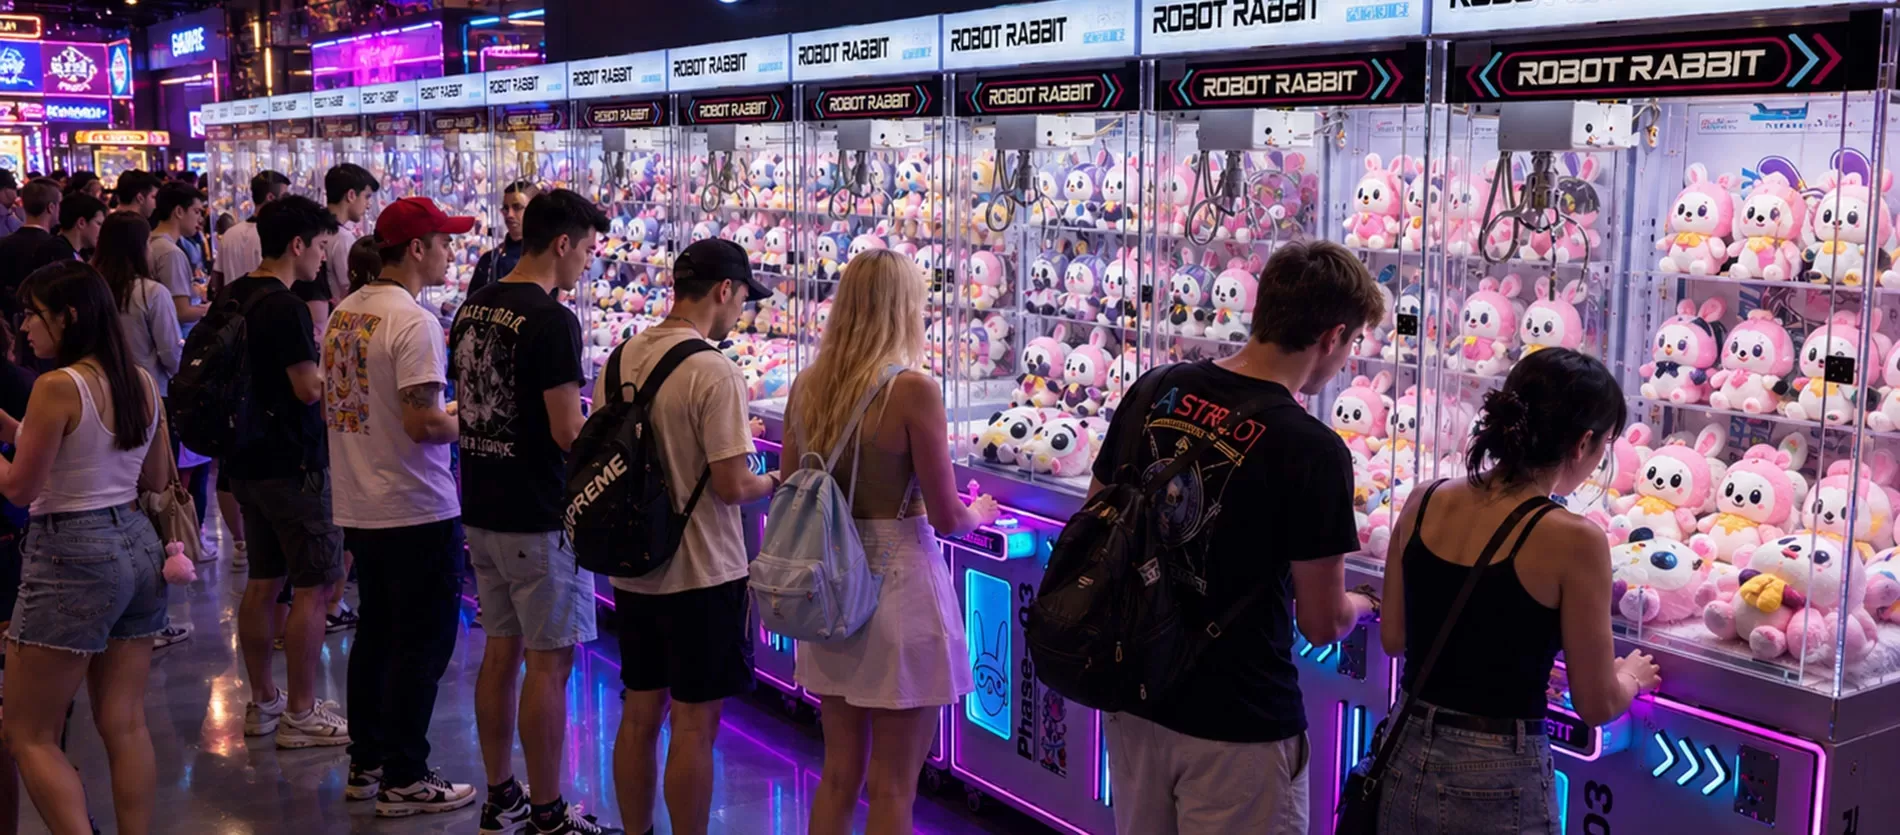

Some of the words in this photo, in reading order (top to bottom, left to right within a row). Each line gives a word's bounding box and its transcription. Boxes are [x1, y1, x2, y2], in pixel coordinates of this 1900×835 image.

[1153, 0, 1229, 33] ROBOT
[1232, 0, 1319, 27] RABBIT
[951, 25, 1002, 52] ROBOT
[1006, 17, 1068, 47] RABBIT
[798, 43, 839, 65] ROBOT
[842, 37, 889, 62] RABBIT
[572, 70, 600, 87] ROBOT
[601, 67, 632, 84] RABBIT
[673, 57, 706, 77] ROBOT
[709, 53, 748, 74] RABBIT
[1518, 57, 1624, 86] ROBOT
[1629, 50, 1766, 81] RABBIT
[989, 87, 1036, 105] ROBOT
[1039, 84, 1095, 103] RABBIT
[1203, 74, 1271, 97] ROBOT
[1275, 70, 1357, 94] RABBIT
[699, 104, 729, 118] ROBOT
[731, 101, 767, 116] RABBIT
[829, 96, 866, 111] ROBOT
[868, 92, 911, 109] RABBIT
